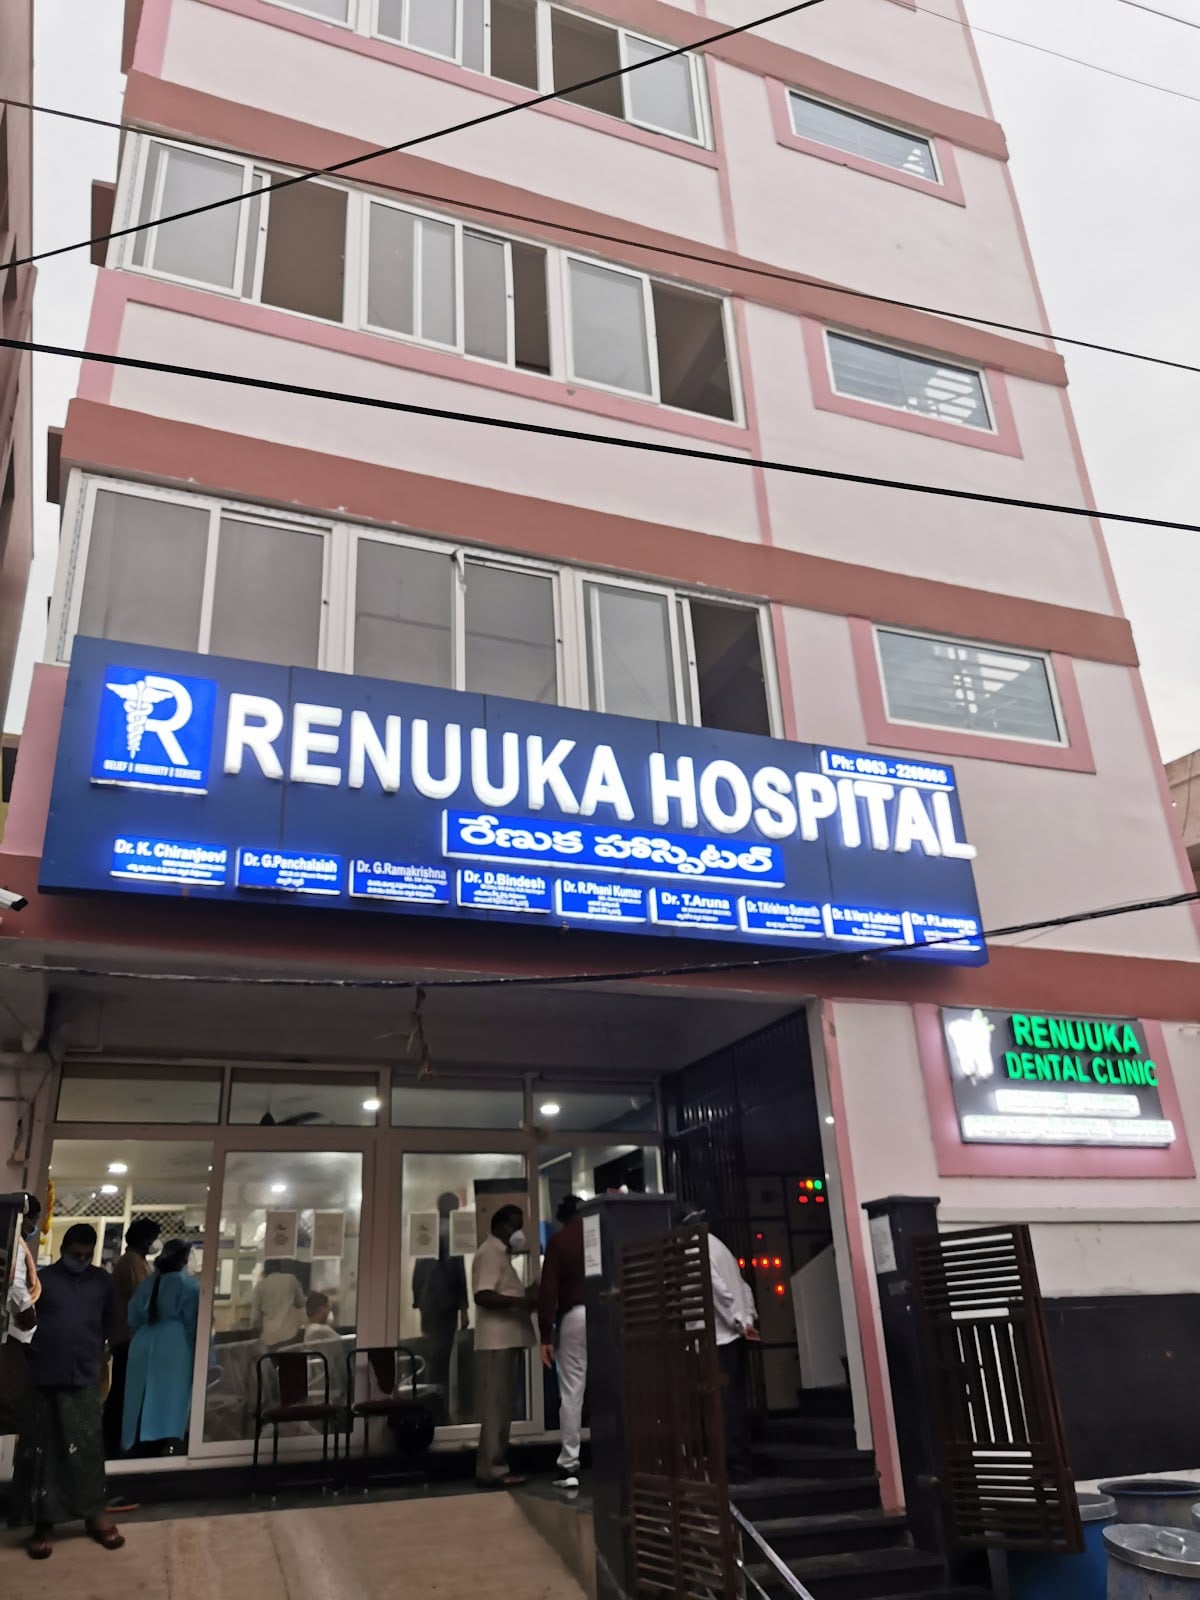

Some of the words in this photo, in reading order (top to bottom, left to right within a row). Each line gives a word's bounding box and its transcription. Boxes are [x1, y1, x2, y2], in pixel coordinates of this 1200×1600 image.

[223, 692, 635, 822] RENUUKA
[649, 752, 978, 860] HOSPITAL
[114, 838, 136, 854] Dr.
[136, 841, 153, 857] K.
[153, 843, 227, 863] Chiranjeevi
[458, 814, 584, 854] రేణుక
[594, 833, 773, 875] హాస్పిటల్
[243, 852, 261, 867] Dr.
[356, 860, 372, 873] Dr.
[372, 861, 447, 879] G.Ramakrishna
[463, 869, 482, 884] Dr.
[484, 871, 546, 890] D.Bindesh
[563, 880, 578, 893] Dr.
[577, 881, 613, 896] R.Phani
[613, 885, 643, 899] Kumar
[661, 891, 681, 906] Dr.
[681, 893, 731, 910] T.Aruna
[746, 900, 759, 914] Dr.
[831, 907, 845, 921] Dr.
[911, 912, 928, 927] Dr.
[1011, 1013, 1142, 1055] RENUUKA
[1004, 1051, 1091, 1084] DENTAL
[1091, 1056, 1159, 1087] CLINIC
